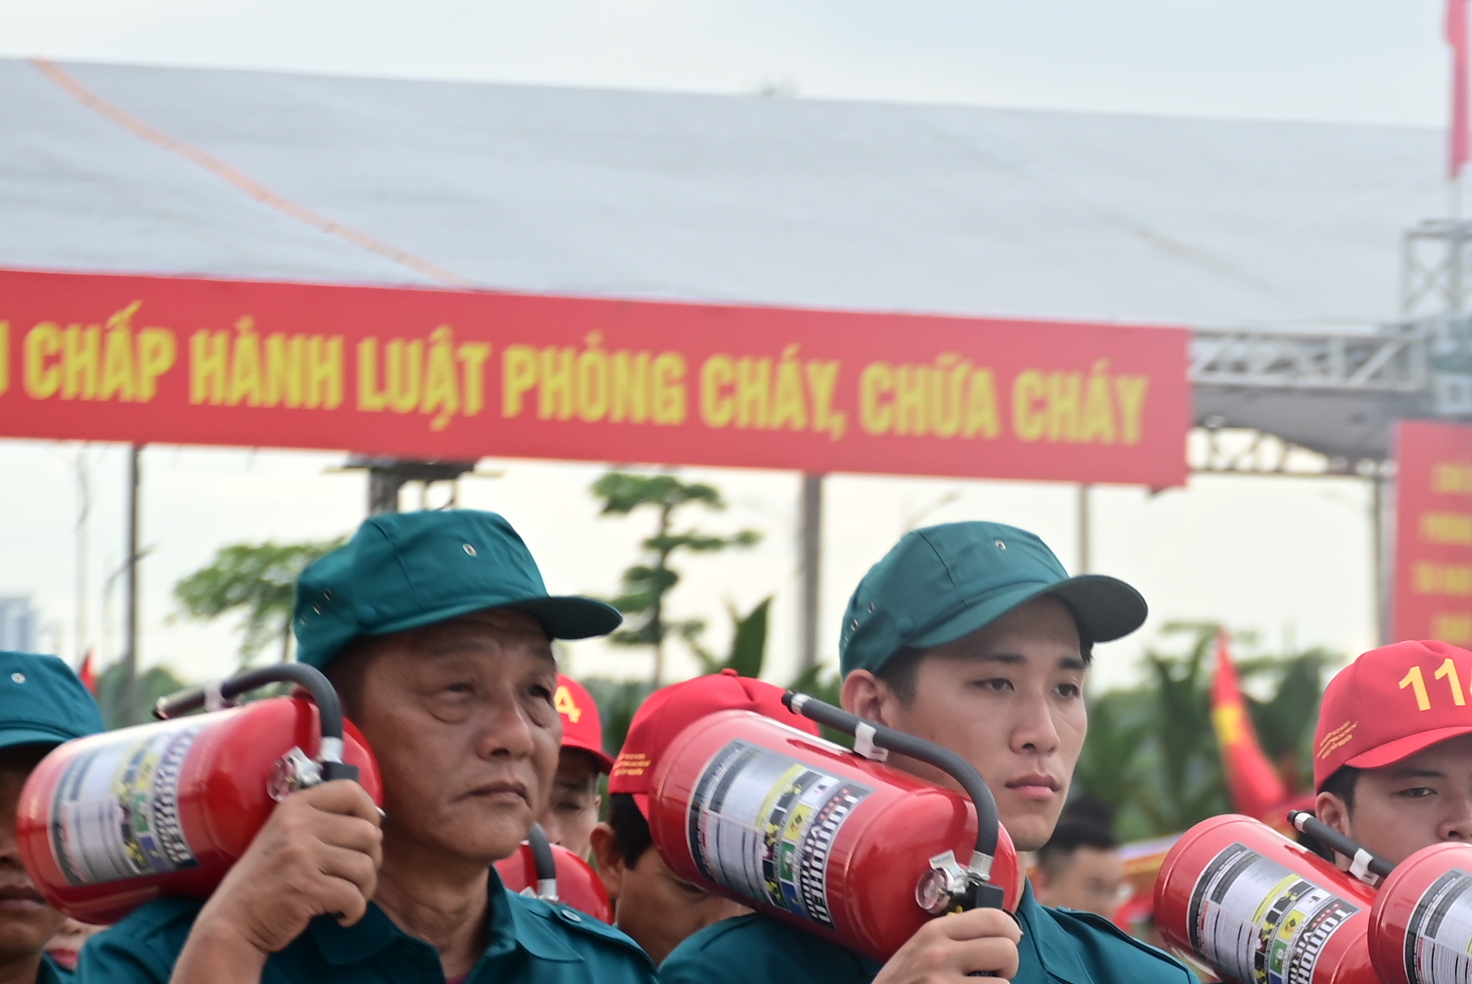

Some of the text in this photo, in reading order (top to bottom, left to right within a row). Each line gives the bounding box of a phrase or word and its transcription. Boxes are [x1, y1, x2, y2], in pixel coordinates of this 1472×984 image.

[22, 299, 178, 403] CHẤP
[189, 315, 344, 409] HÀNH
[356, 325, 492, 431] LUẬT
[501, 330, 687, 427] PHÒNG
[701, 343, 848, 442] CHÁY,
[859, 352, 1000, 440] CHỮA
[1013, 359, 1149, 446] CHÁY
